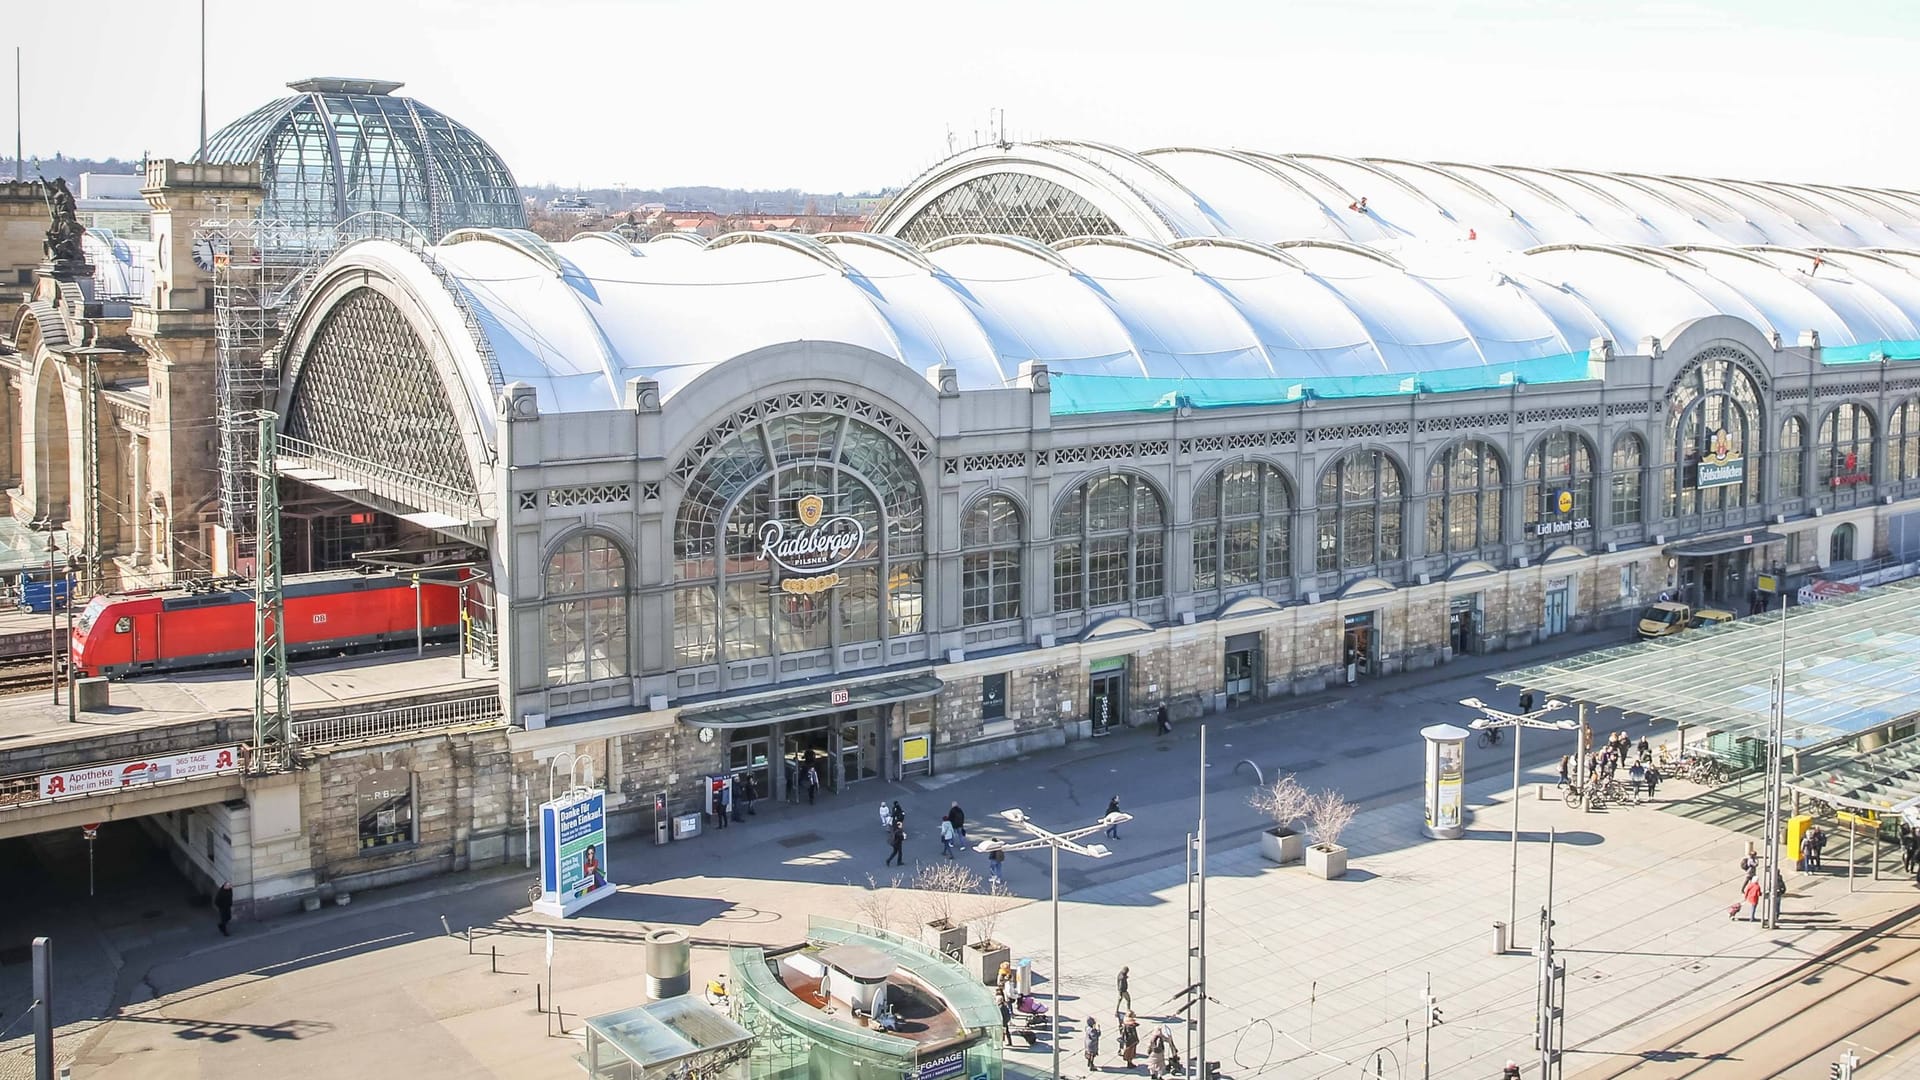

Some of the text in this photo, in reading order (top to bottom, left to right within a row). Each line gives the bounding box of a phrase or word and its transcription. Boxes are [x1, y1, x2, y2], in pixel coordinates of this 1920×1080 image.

[1537, 517, 1592, 535] Lidl lohnt sich.
[757, 518, 862, 566] Radeberger
[794, 557, 828, 566] PILSNER
[314, 615, 326, 623] DB
[834, 692, 848, 703] DB
[190, 754, 207, 764] TAGE
[69, 768, 113, 784] Apotheke
[176, 763, 210, 777] bis 22 Uhr
[69, 774, 115, 793] hier im HBF
[561, 802, 590, 821] Danke für
[561, 807, 602, 832] Ihren Einkauf.
